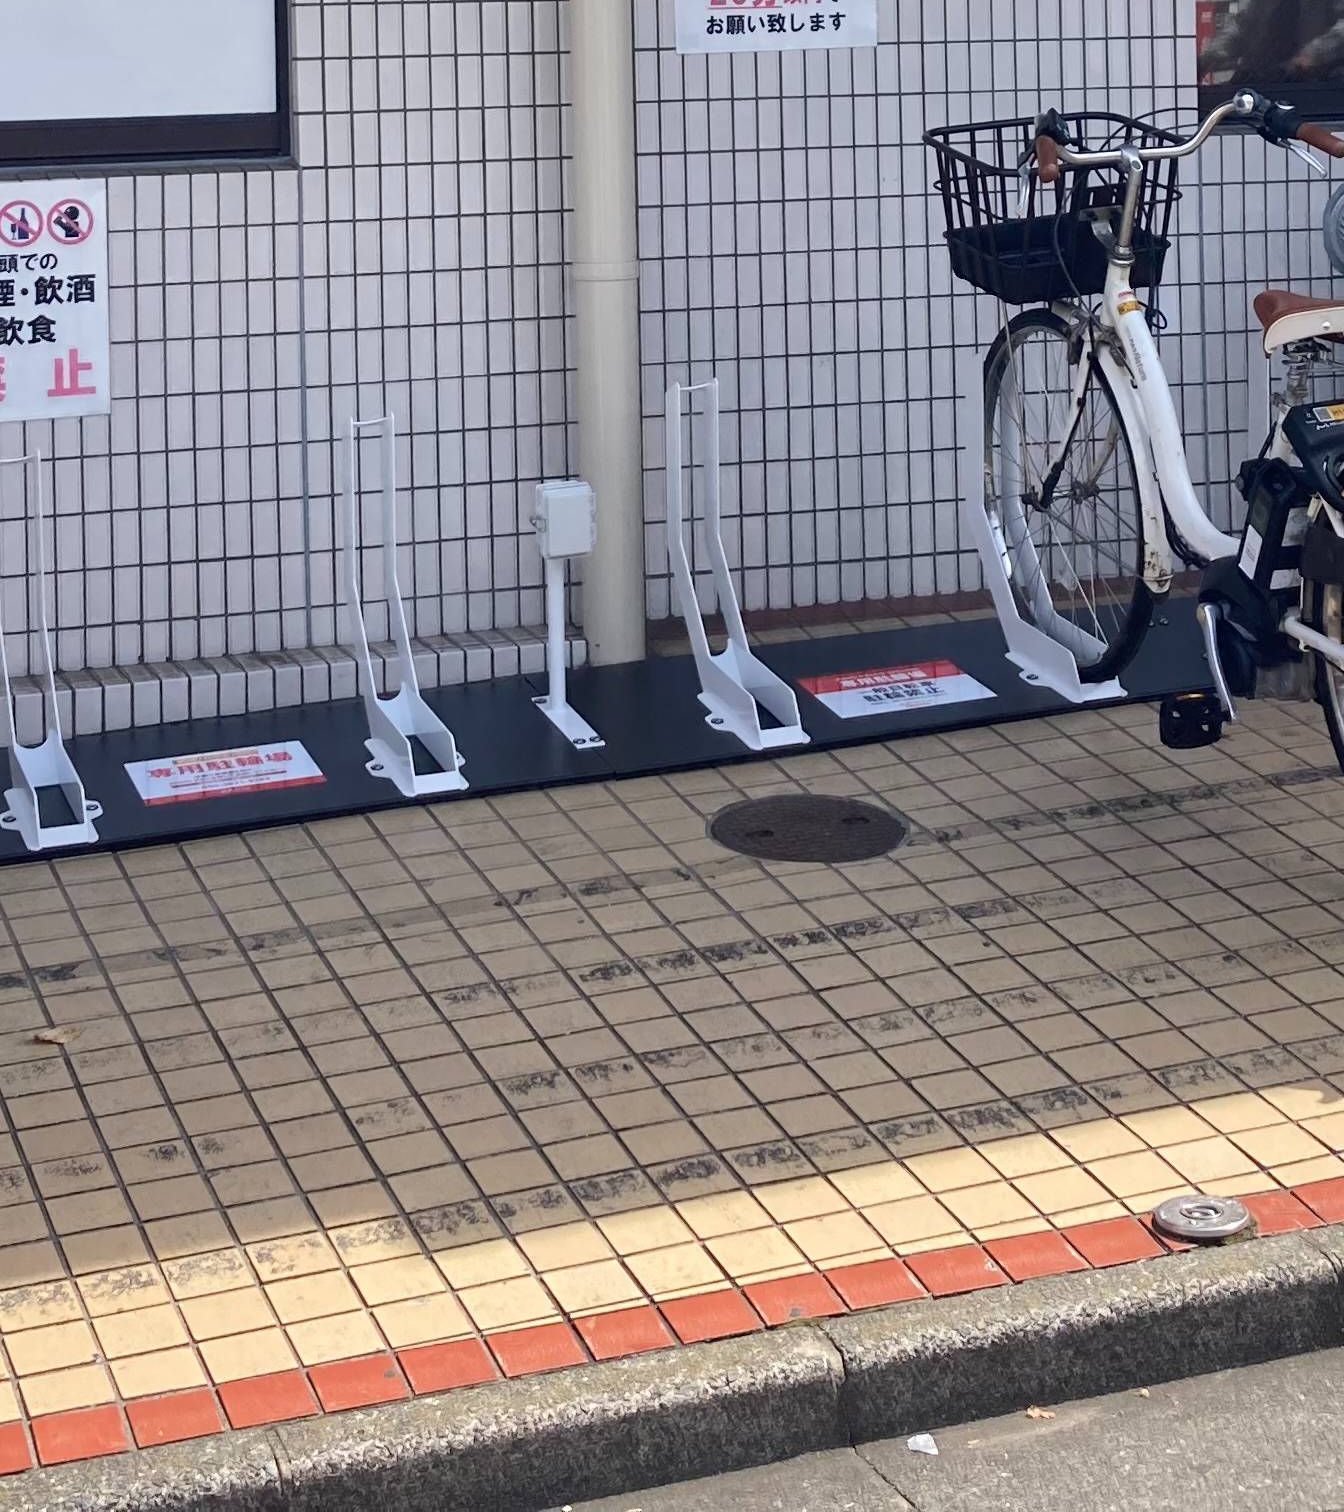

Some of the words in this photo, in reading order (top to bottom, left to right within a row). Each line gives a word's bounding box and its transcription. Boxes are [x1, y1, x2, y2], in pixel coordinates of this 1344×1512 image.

[706, 12, 846, 35] お願い致します
